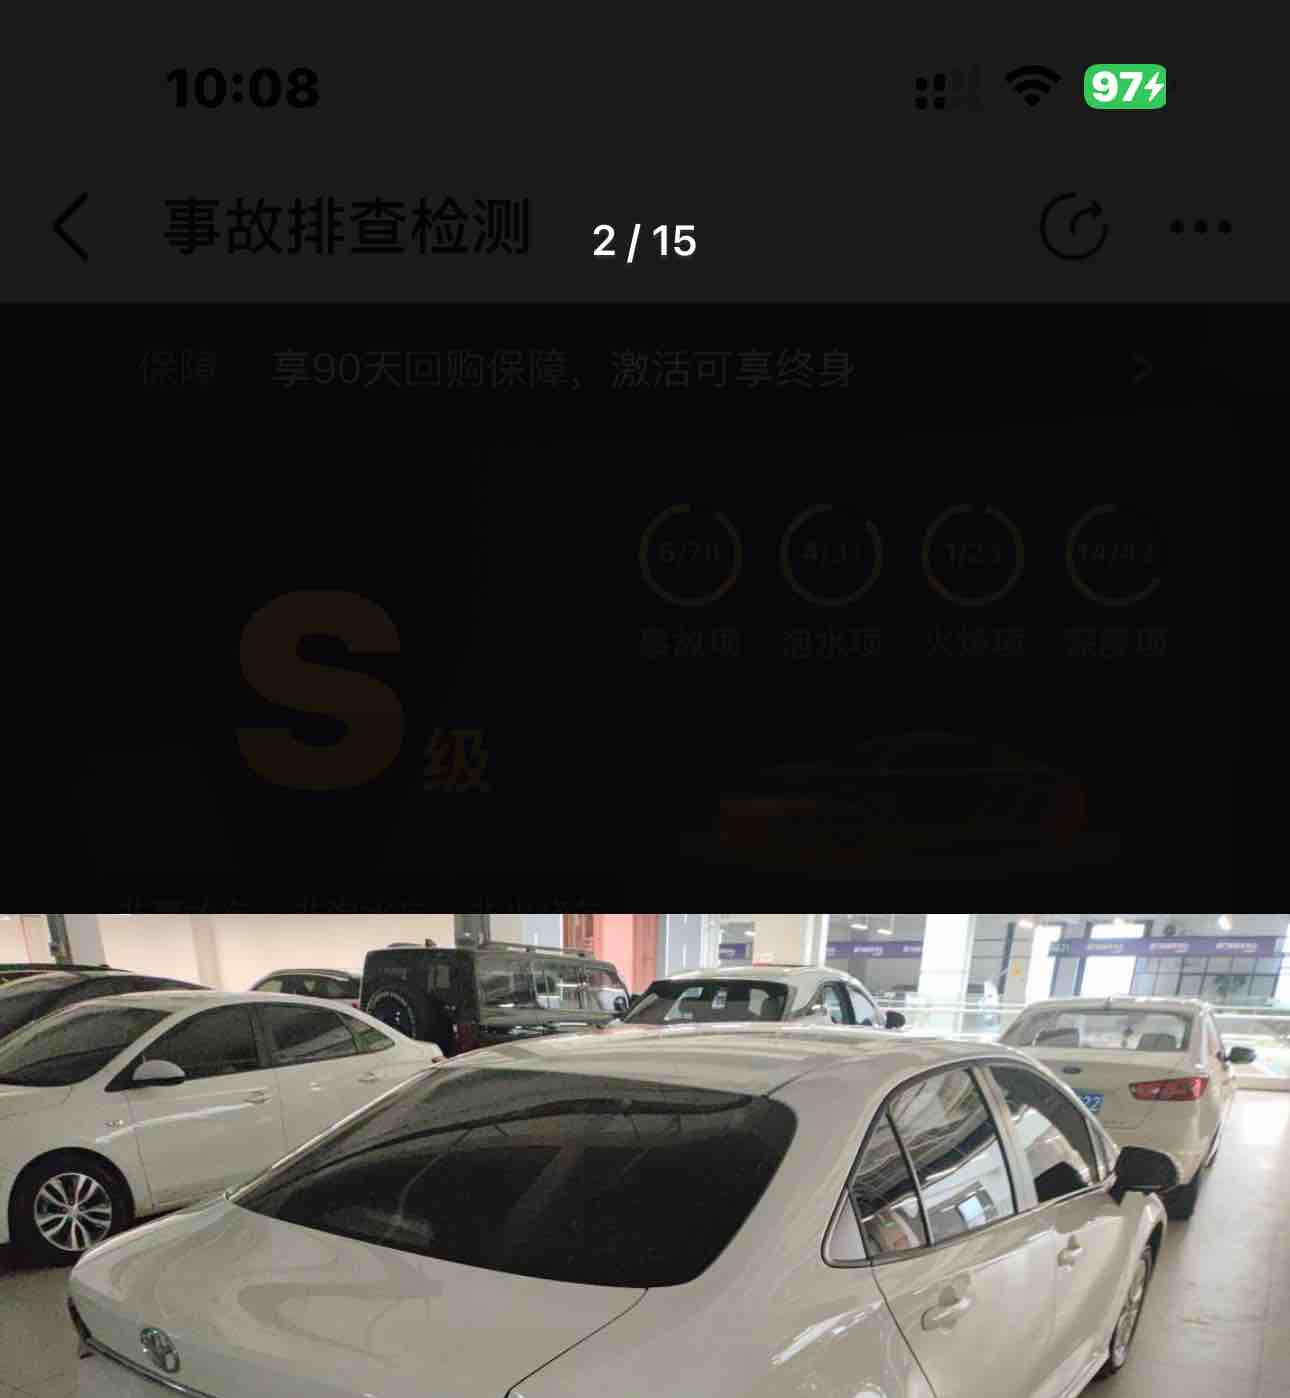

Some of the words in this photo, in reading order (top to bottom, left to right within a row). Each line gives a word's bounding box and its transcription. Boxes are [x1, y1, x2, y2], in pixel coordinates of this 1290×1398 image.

[166, 67, 320, 109] 10:08
[1092, 70, 1142, 103] 97
[163, 196, 530, 256] 事故排查检测
[593, 225, 615, 256] 2
[627, 223, 640, 264] /
[653, 225, 697, 256] 15
[237, 590, 405, 790] S
